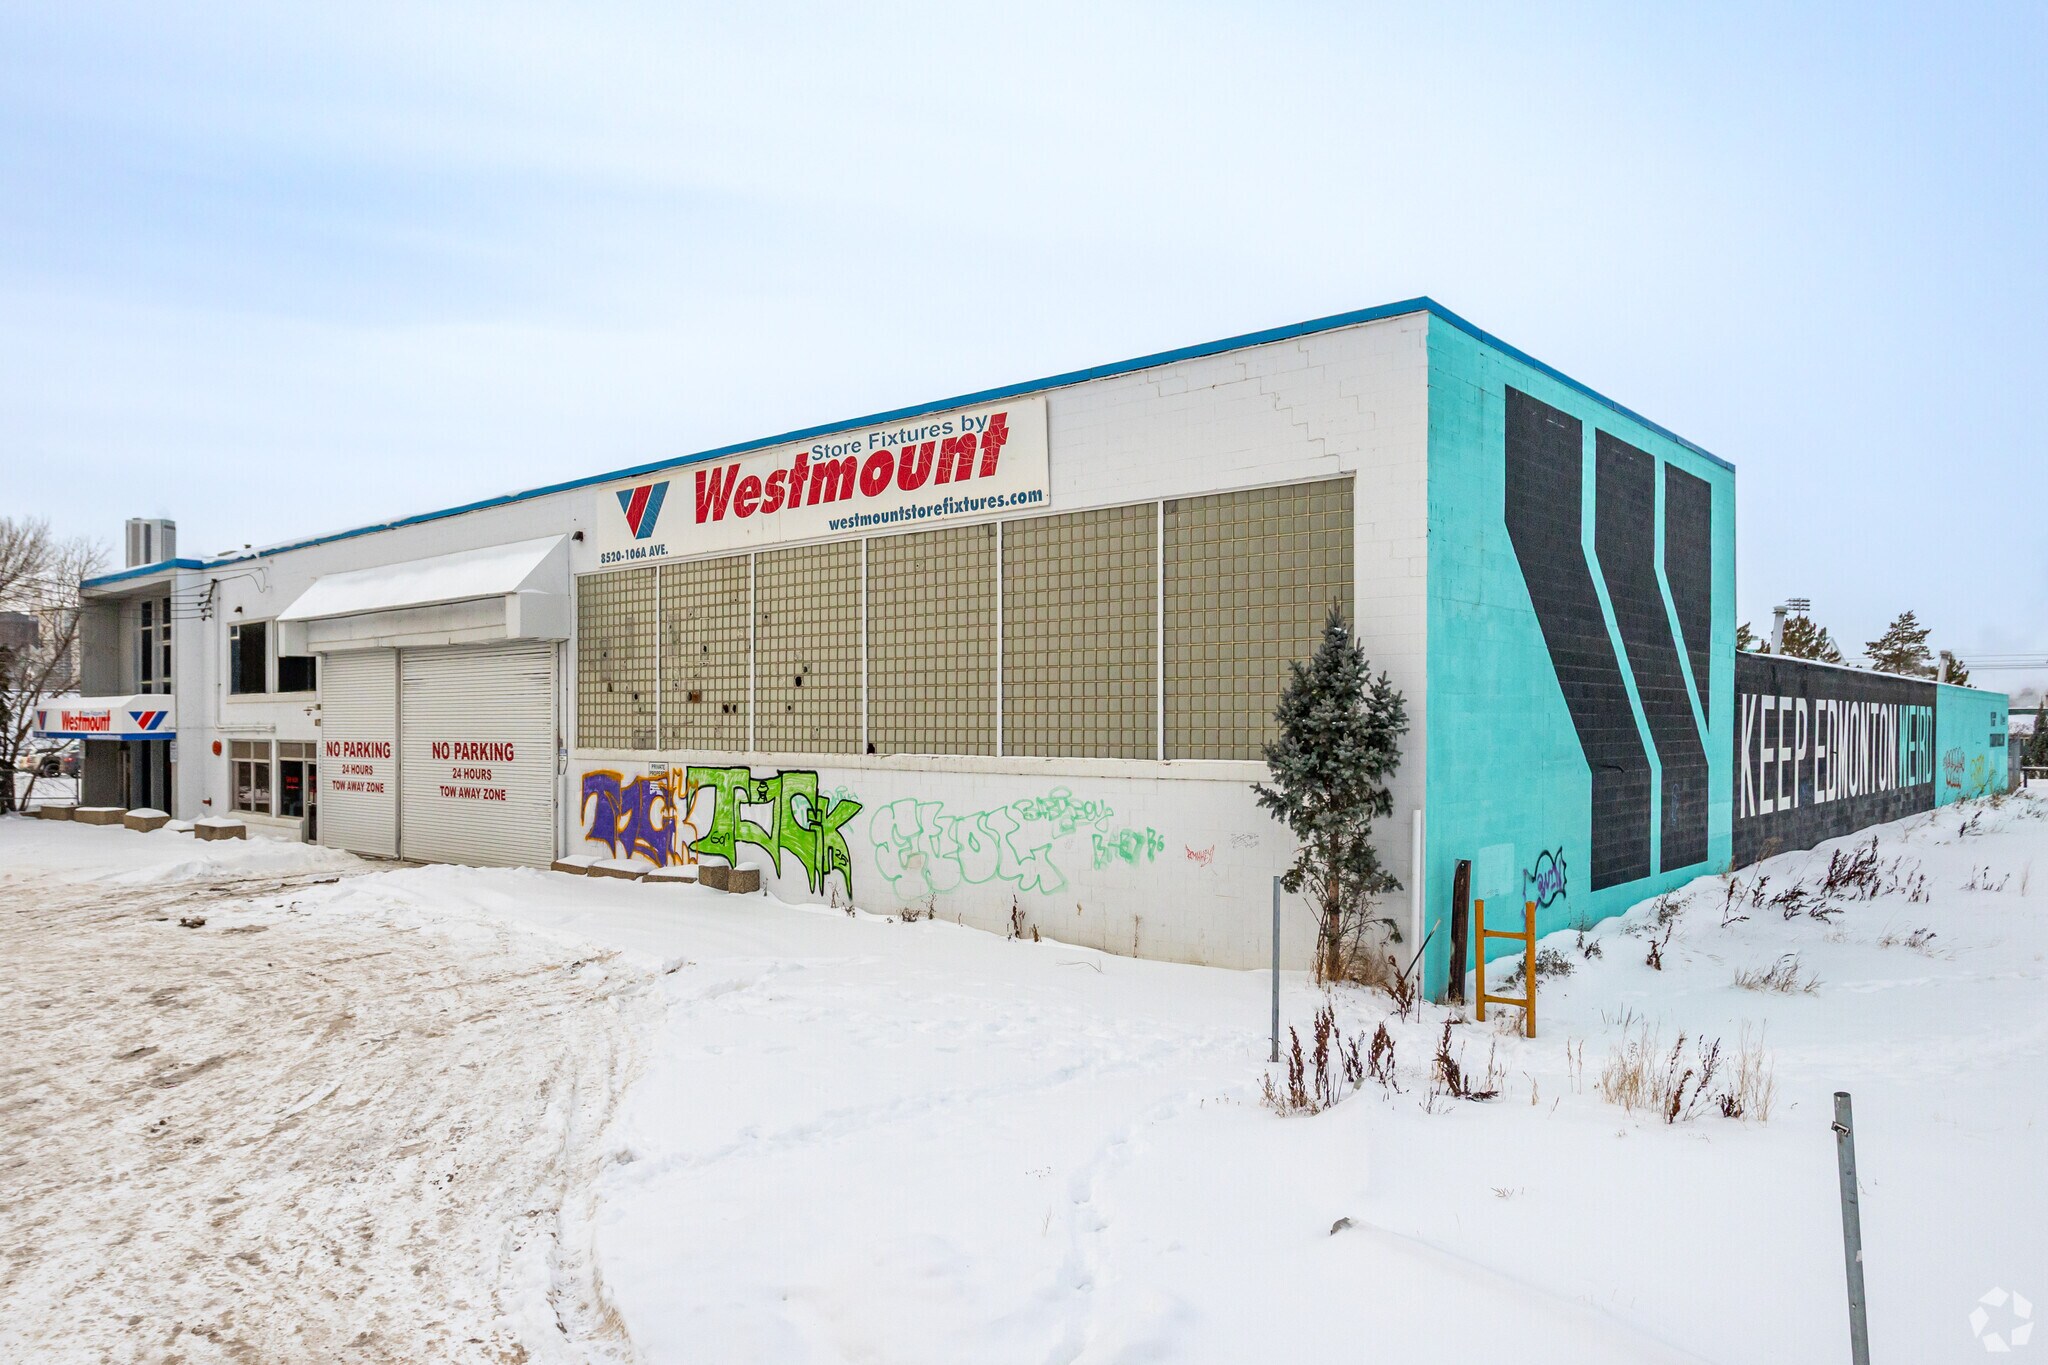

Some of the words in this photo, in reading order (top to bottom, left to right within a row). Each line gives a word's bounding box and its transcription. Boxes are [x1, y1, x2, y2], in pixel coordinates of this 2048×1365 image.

[811, 438, 862, 461] Store
[868, 423, 953, 450] Fixtures
[961, 414, 987, 432] by
[695, 412, 1009, 524] Westmount
[828, 488, 1043, 530] westmountstorefixtures.com
[600, 546, 647, 564] 8520-106A
[649, 543, 669, 557] AVE.
[61, 709, 111, 732] Westmount
[326, 741, 341, 757] NO
[343, 741, 391, 758] PARKING
[432, 741, 450, 760] NO
[454, 742, 514, 761] PARKING
[1740, 693, 1808, 819] KEEP
[1814, 698, 1898, 805] EDMONTON
[1898, 704, 1933, 789] WEIRD
[342, 764, 350, 774] 24
[351, 765, 374, 775] HOURS
[452, 767, 461, 779] 24
[463, 768, 492, 780] HOURS
[332, 780, 346, 791] TOW
[347, 781, 365, 792] AWAY
[366, 782, 385, 793] ZONE
[439, 785, 457, 798] TOW
[458, 786, 481, 799] AWAY
[483, 788, 506, 801] ZONE
